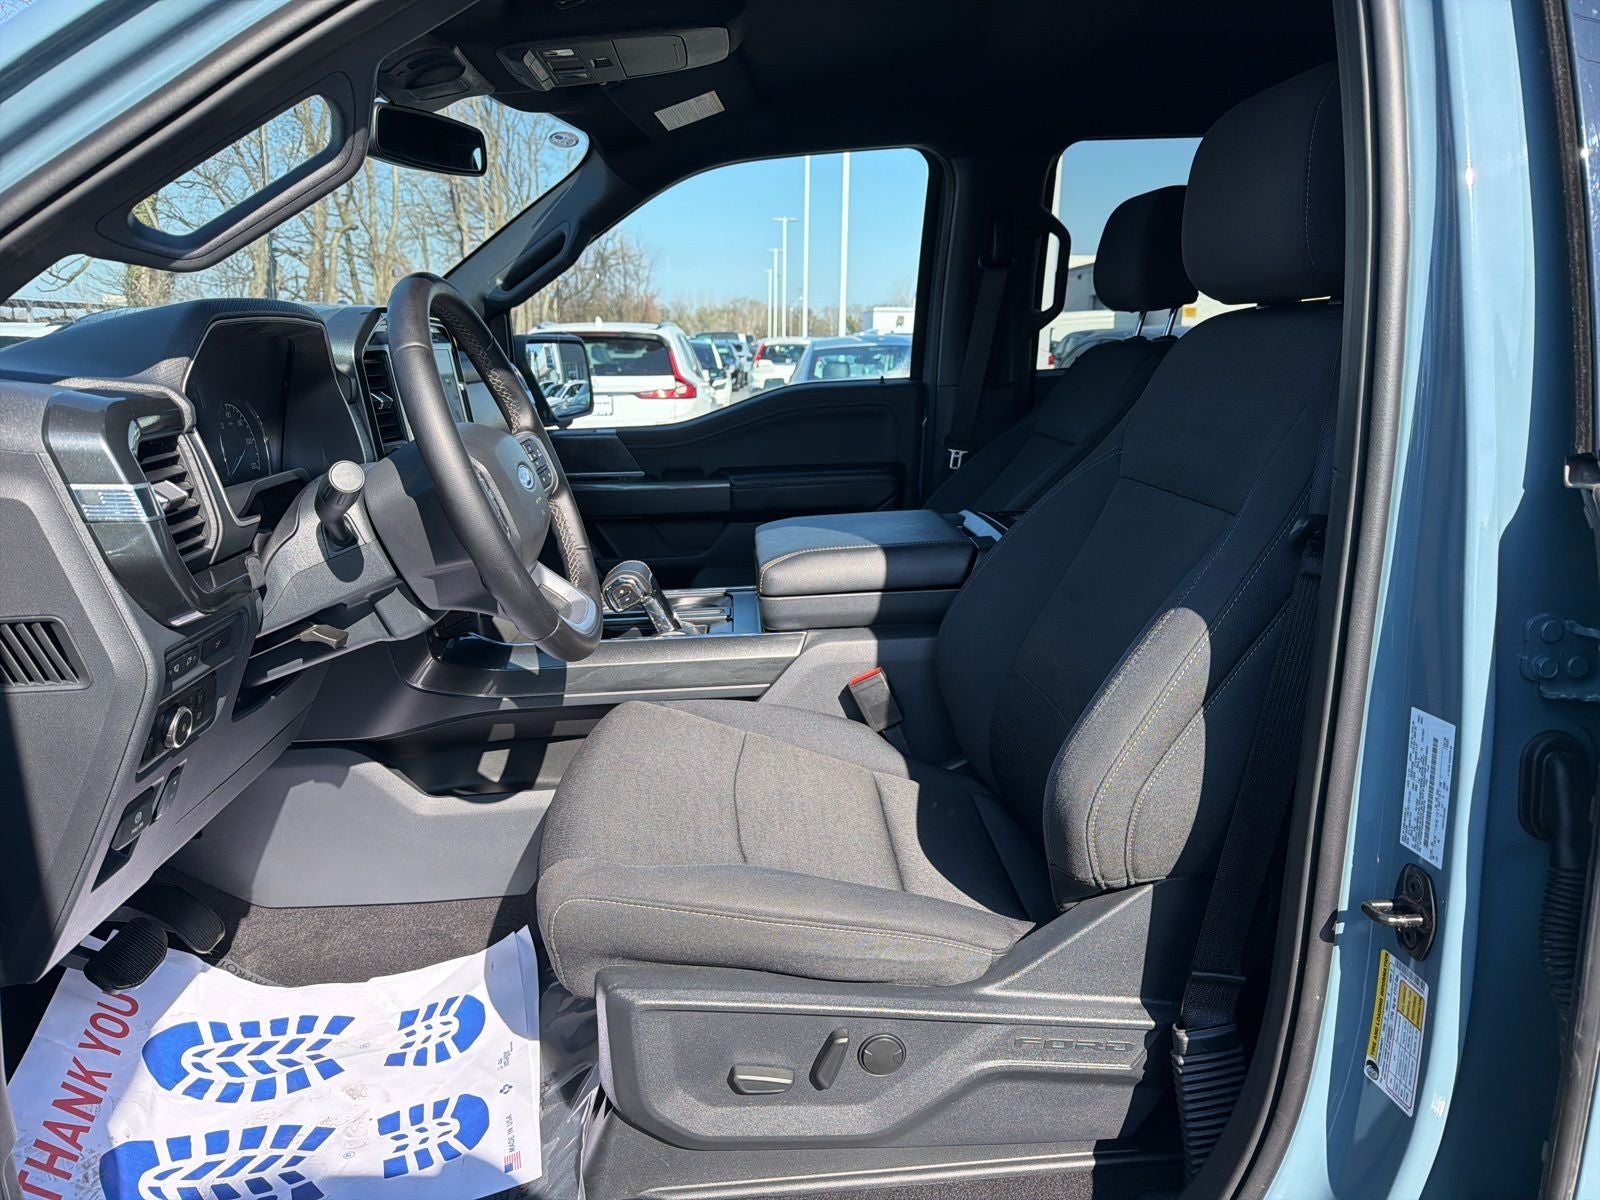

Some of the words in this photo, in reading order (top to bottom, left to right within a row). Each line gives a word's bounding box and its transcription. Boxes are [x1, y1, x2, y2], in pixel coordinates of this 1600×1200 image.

[1376, 997, 1384, 1027] LOADING
[1381, 952, 1389, 997] INFORMATION
[1013, 1036, 1135, 1052] FORD
[17, 1056, 112, 1200] THANK
[78, 992, 139, 1056] YOU
[505, 1114, 513, 1127] USA
[507, 1135, 516, 1153] MADE
